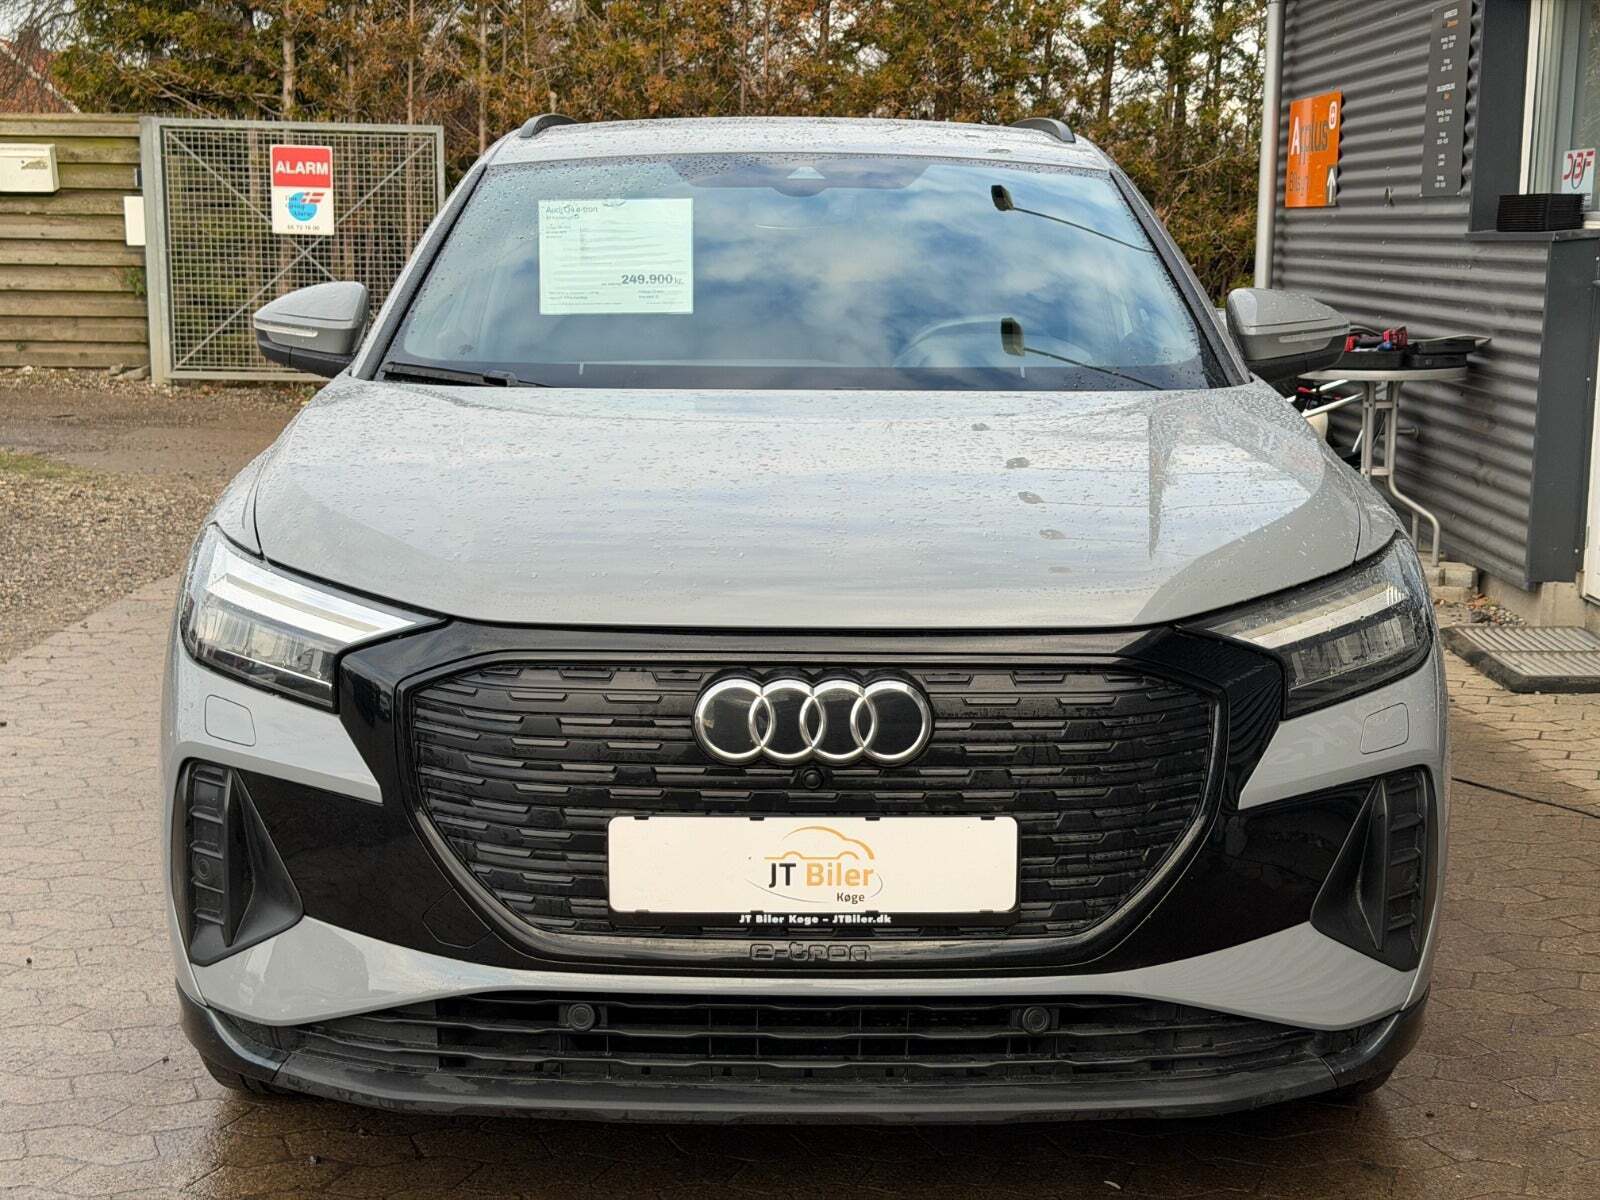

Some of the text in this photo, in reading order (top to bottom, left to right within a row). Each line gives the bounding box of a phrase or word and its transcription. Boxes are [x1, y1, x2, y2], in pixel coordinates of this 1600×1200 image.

[276, 161, 328, 175] ALARM
[621, 273, 673, 285] 249.900
[769, 862, 874, 888] JT Biler
[836, 892, 865, 905] Køge
[739, 915, 752, 923] JT
[755, 914, 785, 924] Biler
[832, 914, 892, 924] JTBiler.dk
[750, 942, 871, 961] e-tron
